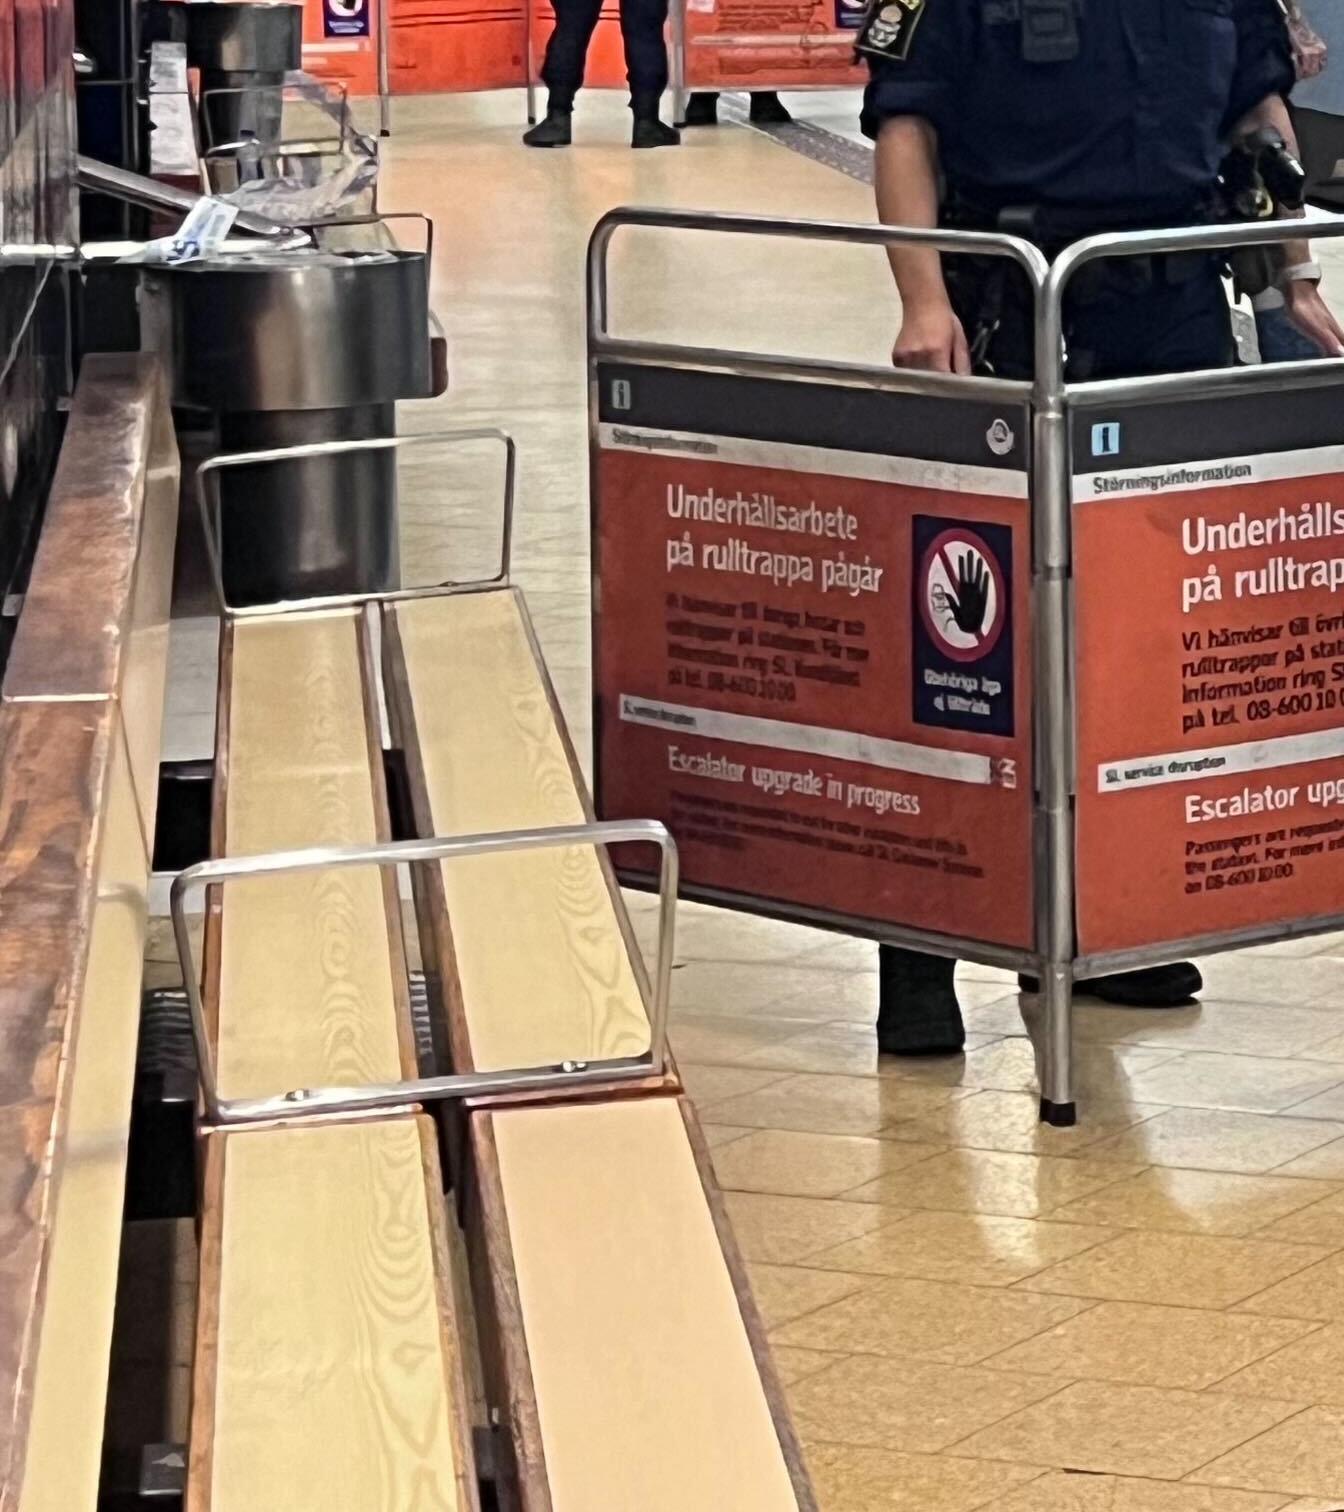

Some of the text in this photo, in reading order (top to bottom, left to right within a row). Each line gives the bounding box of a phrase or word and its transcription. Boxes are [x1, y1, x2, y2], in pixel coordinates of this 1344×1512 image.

[666, 483, 858, 541] Underhållsarbete
[666, 531, 884, 597] på rulltrappa pågår
[1182, 564, 1222, 614] på
[1247, 692, 1312, 721] 08-600
[1316, 688, 1336, 710] 10
[668, 744, 745, 782] Escalator
[751, 768, 822, 796] upgrade
[847, 782, 920, 815] progress
[1185, 785, 1300, 823] Escalator
